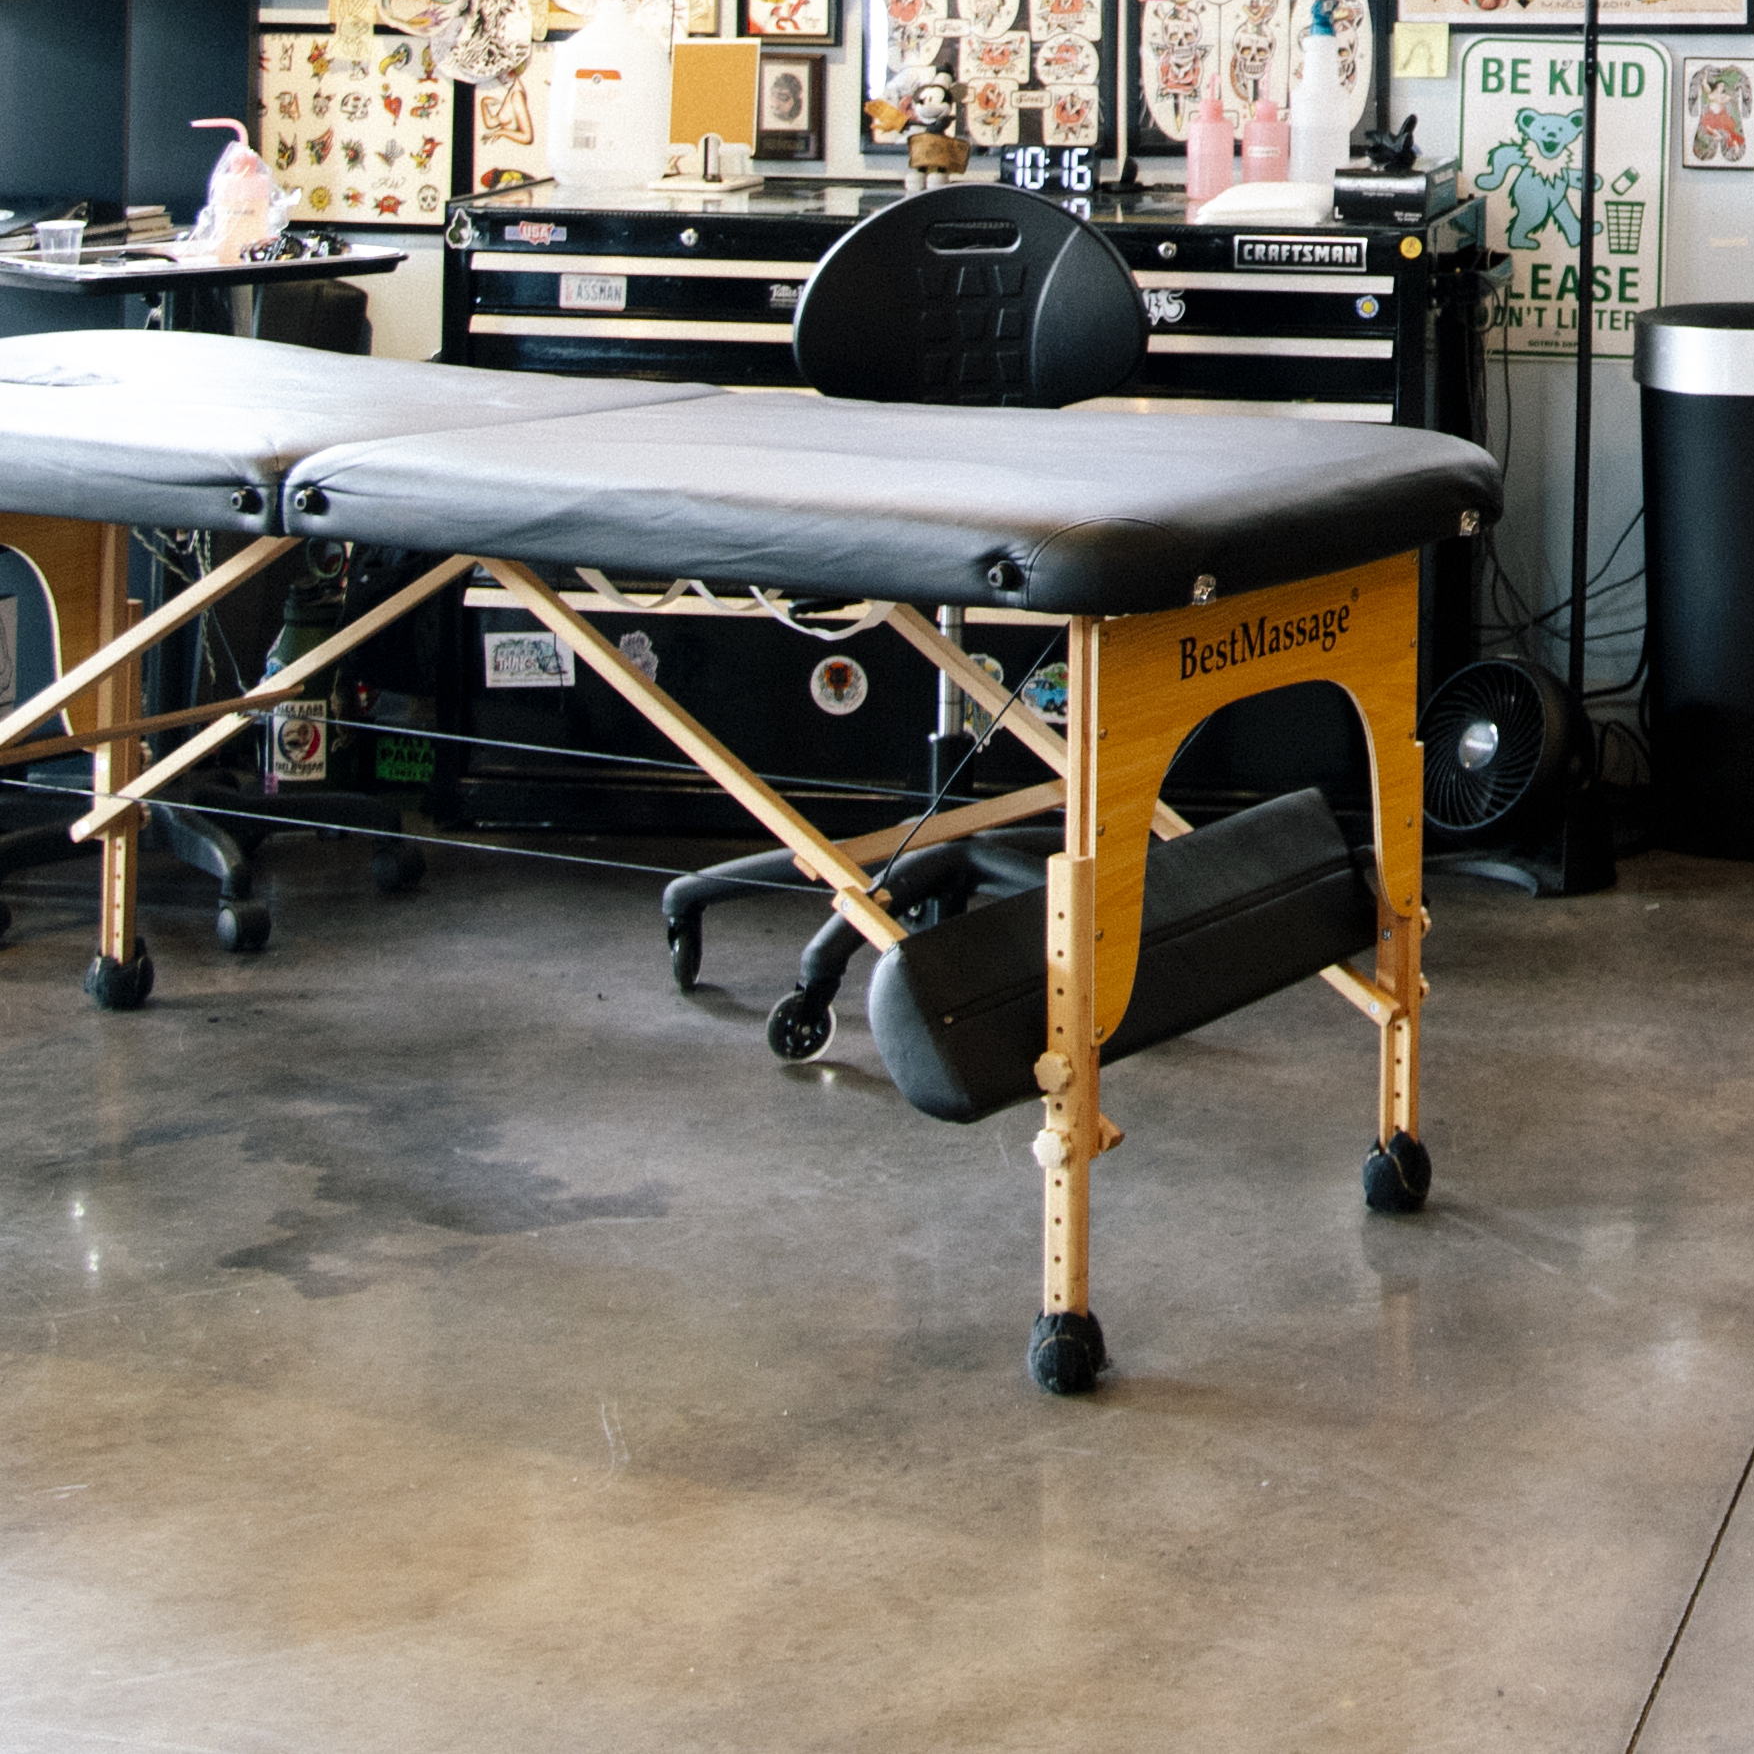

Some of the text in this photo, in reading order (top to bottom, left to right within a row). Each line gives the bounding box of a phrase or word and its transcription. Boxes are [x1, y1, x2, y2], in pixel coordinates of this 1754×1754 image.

[1481, 57, 1646, 98] BE KIND
[519, 225, 549, 240] USA
[1242, 242, 1359, 265] CRAFTSMAN
[576, 283, 623, 304] ASSMAN
[1506, 263, 1640, 304] LEASE
[1494, 305, 1636, 331] ON'T LITER
